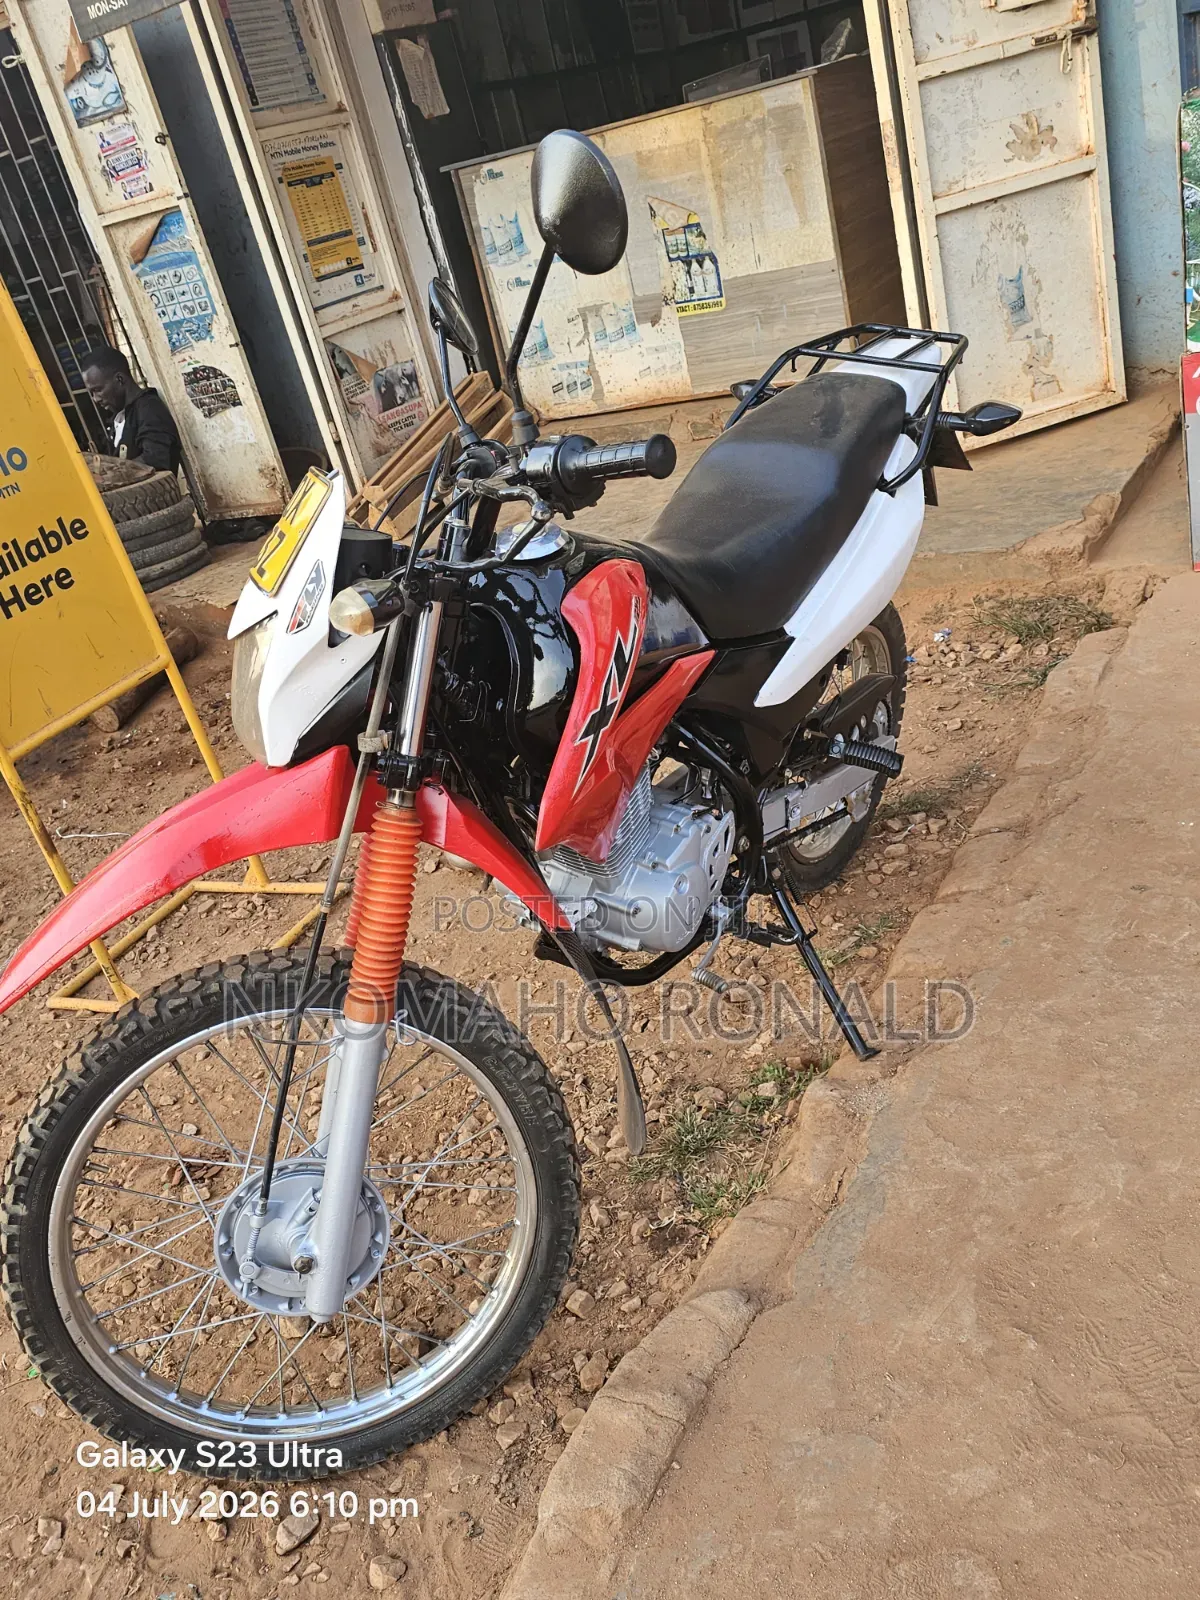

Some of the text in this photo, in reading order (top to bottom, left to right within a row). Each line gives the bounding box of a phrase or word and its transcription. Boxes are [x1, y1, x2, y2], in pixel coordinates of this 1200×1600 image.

[270, 152, 284, 160] MTN
[284, 147, 301, 157] Mobile
[302, 143, 319, 154] Money
[0, 567, 75, 620] Here
